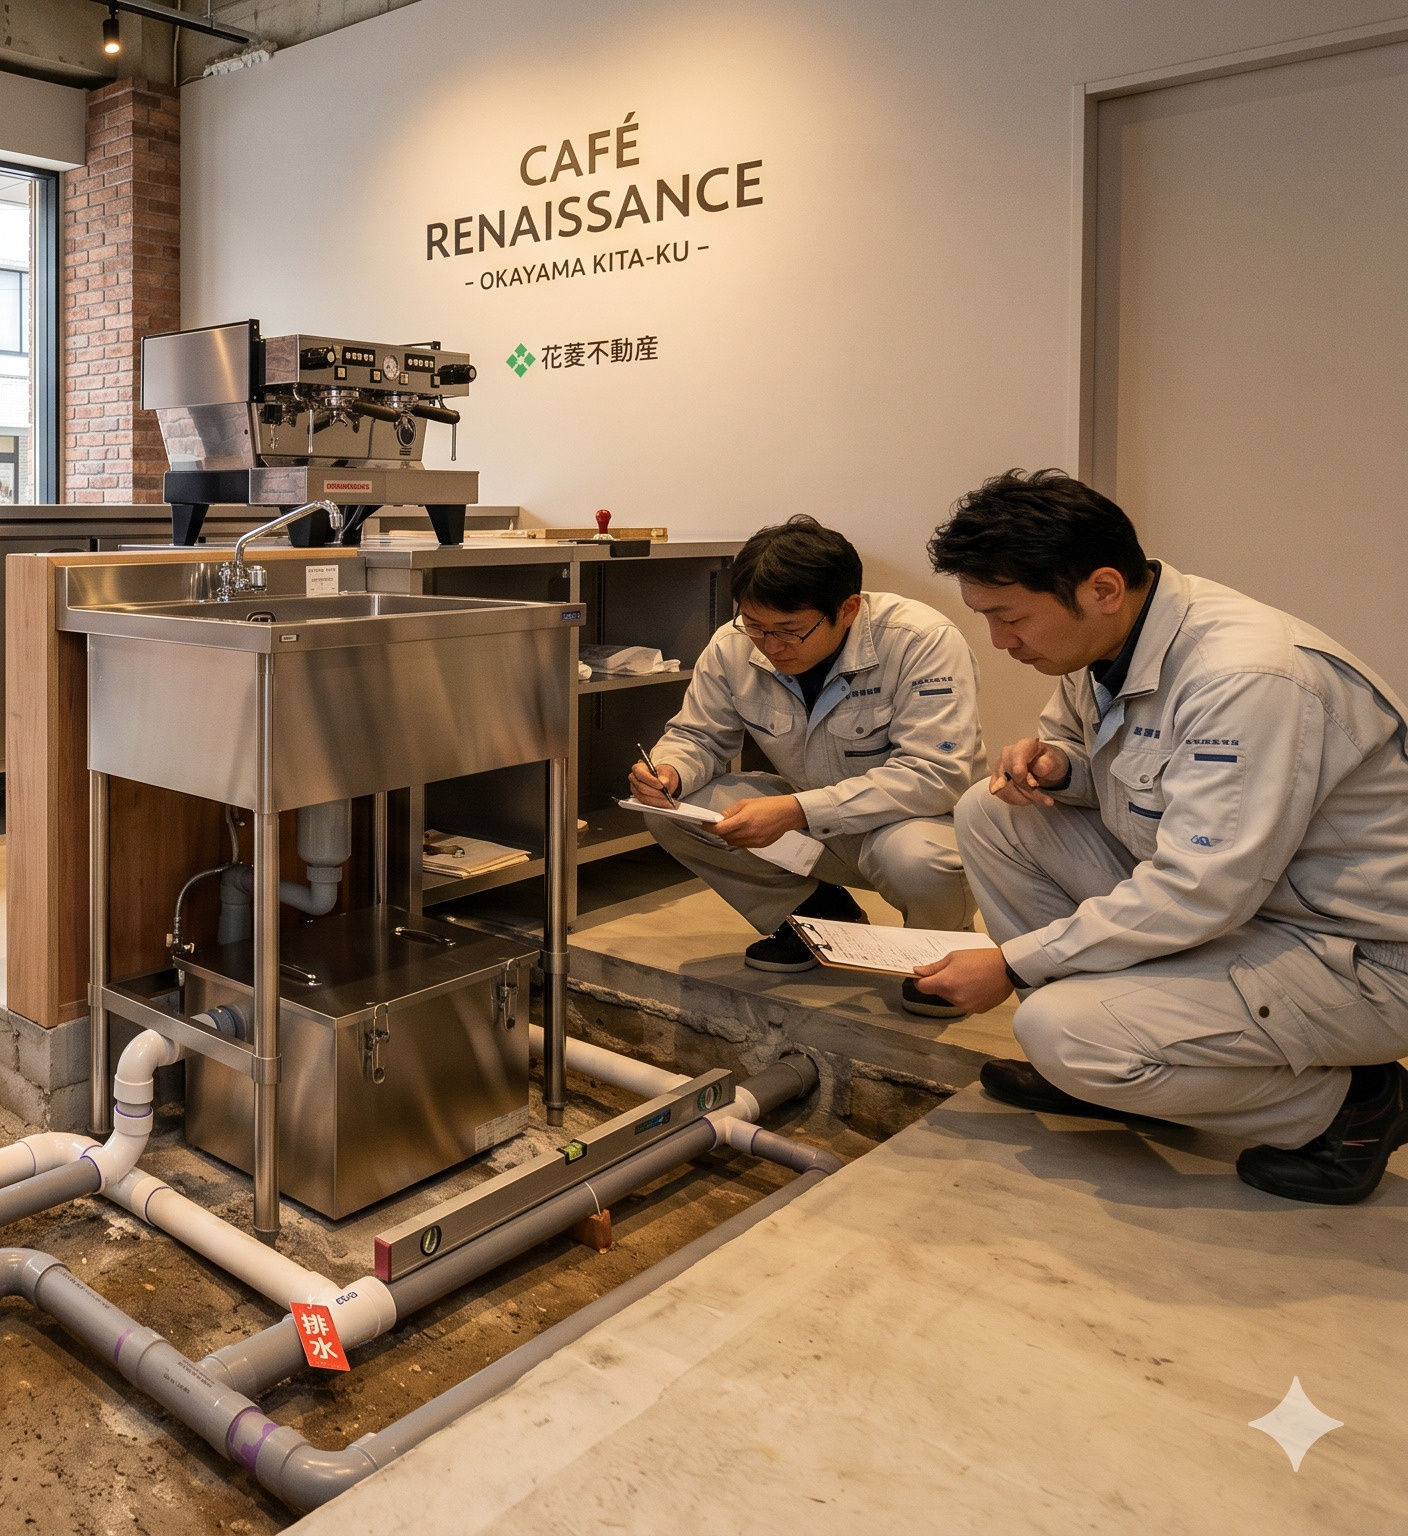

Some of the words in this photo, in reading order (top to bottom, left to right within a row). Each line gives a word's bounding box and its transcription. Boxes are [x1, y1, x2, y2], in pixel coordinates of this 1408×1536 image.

[520, 111, 640, 187] CAFÉ
[426, 159, 764, 261] RENAISSANCE
[480, 257, 586, 291] OKAYAMA
[593, 240, 690, 275] KITA-KU
[541, 335, 659, 371] 花菱不動産
[300, 1312, 339, 1360] 排水
